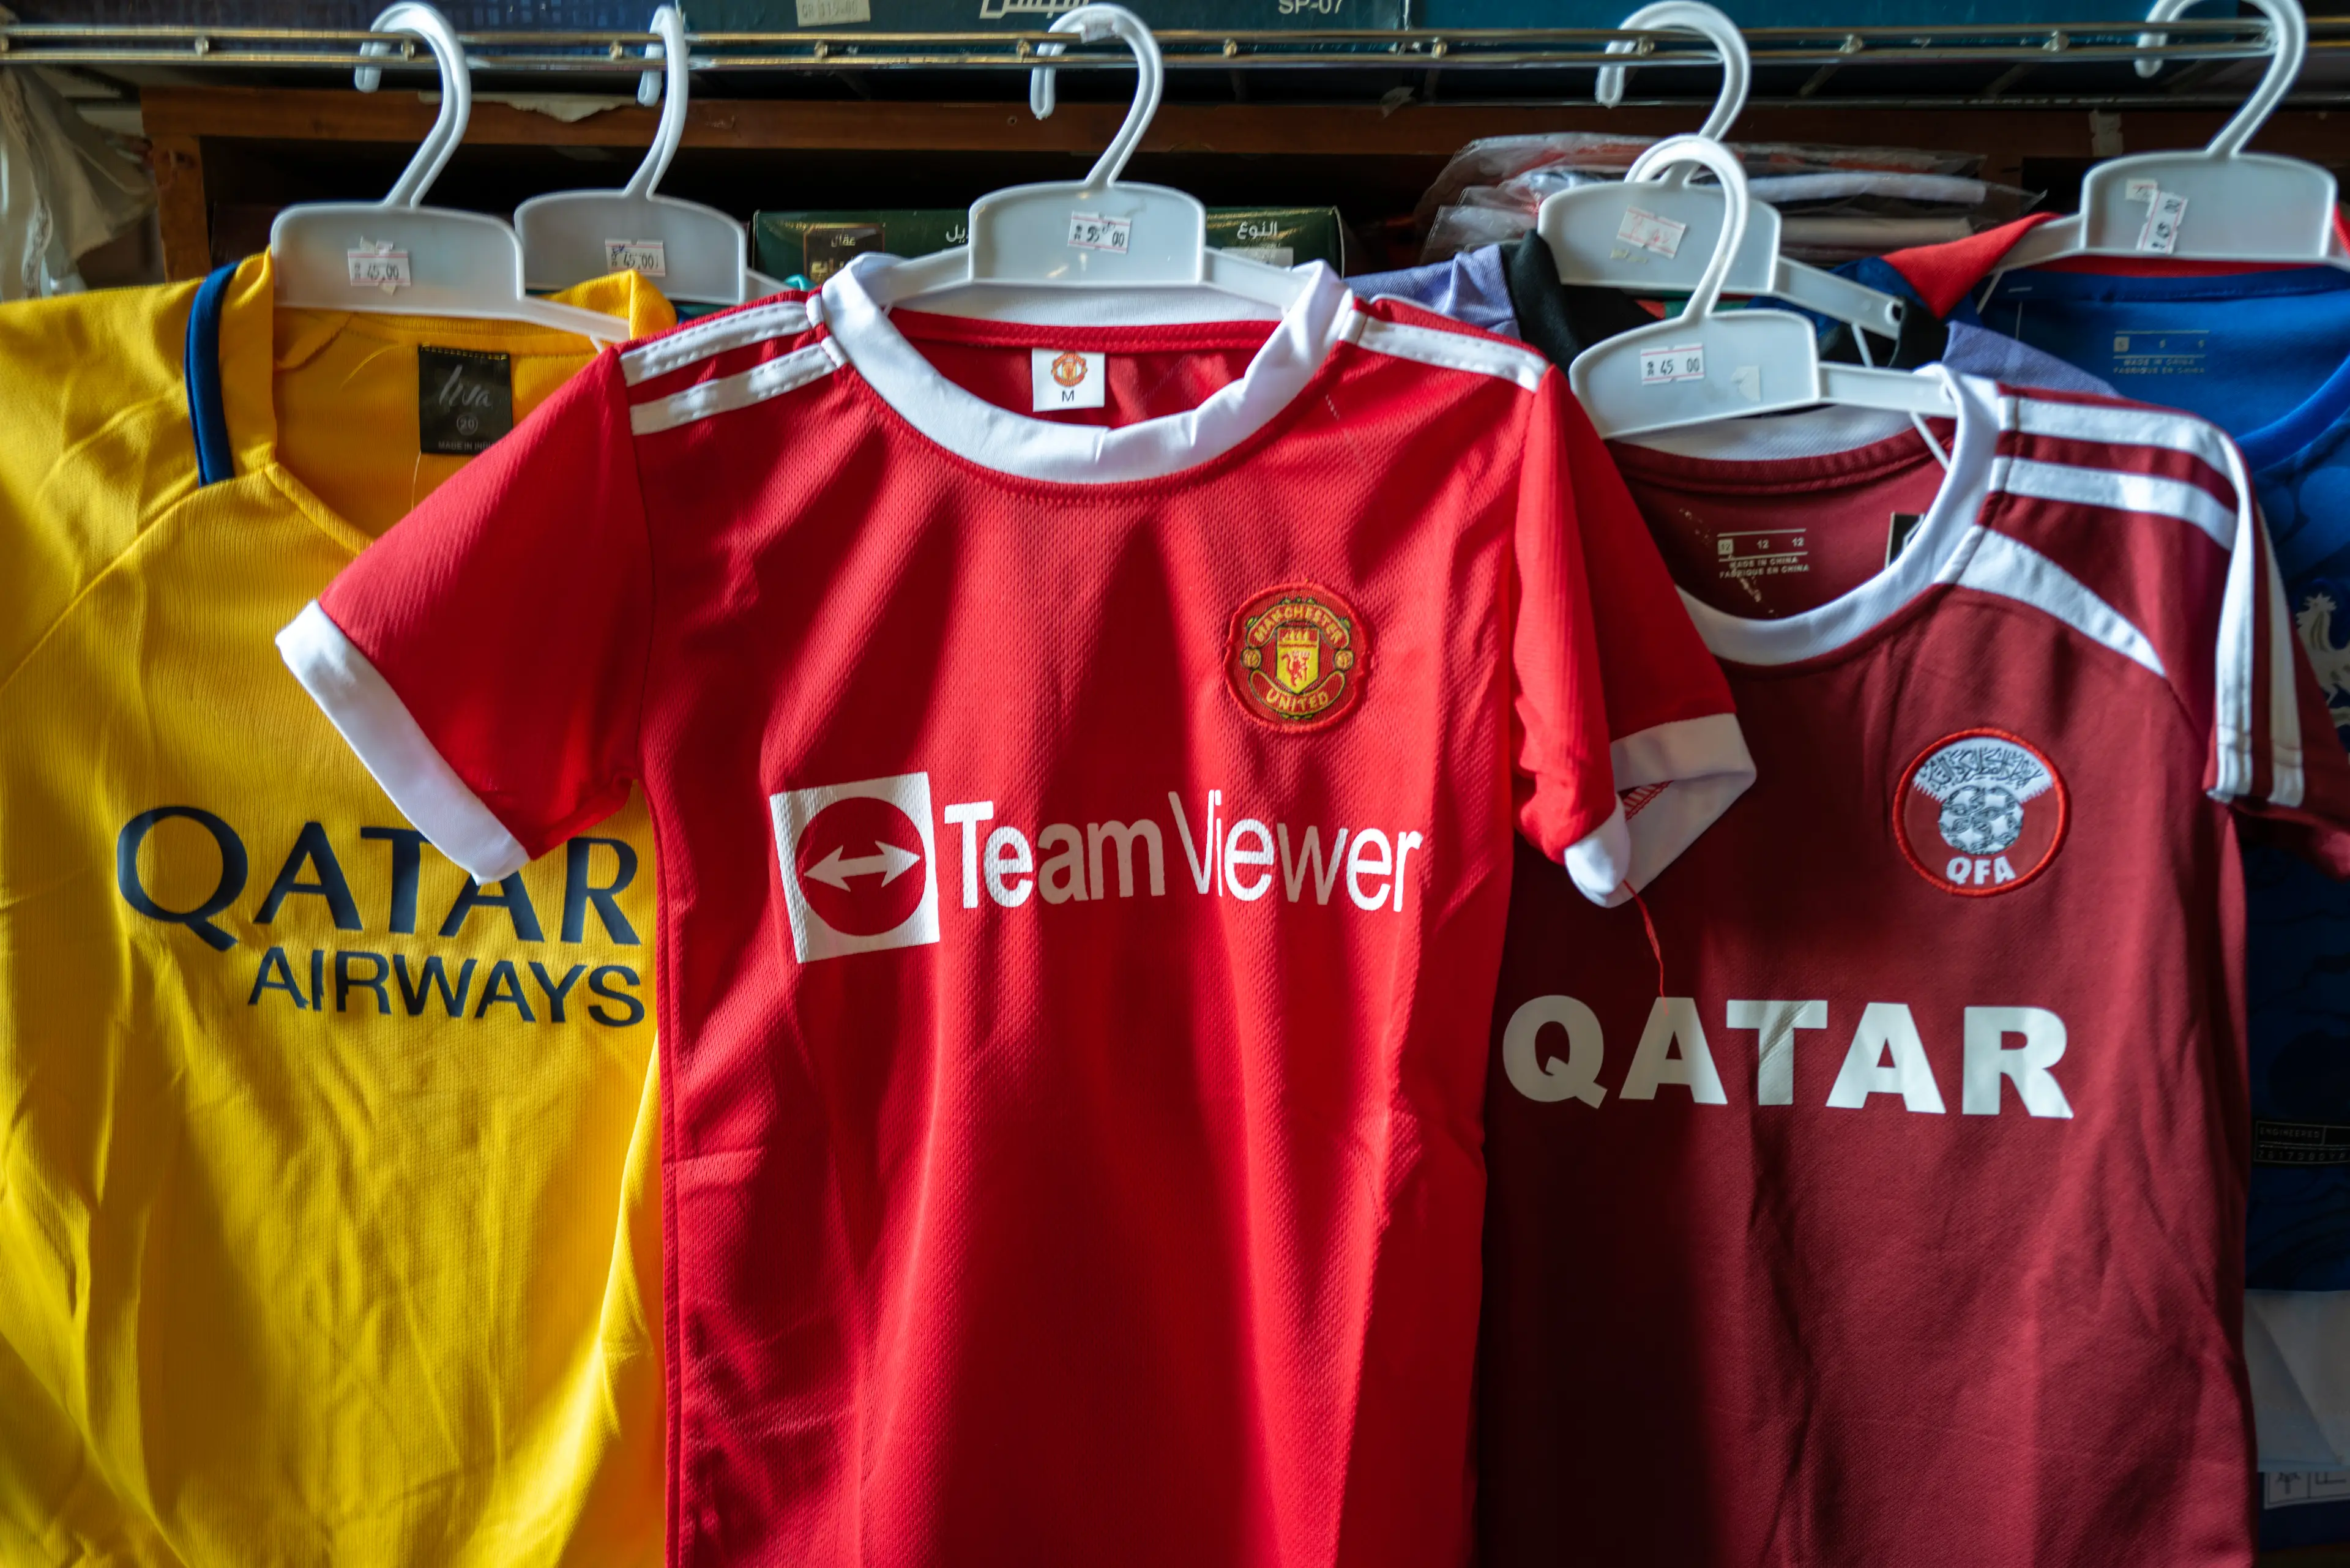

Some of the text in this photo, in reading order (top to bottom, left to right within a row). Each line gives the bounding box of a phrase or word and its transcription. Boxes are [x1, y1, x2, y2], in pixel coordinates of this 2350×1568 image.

[1237, 220, 1278, 240] النوع
[1660, 359, 1674, 375] 45
[1687, 357, 1700, 373] 00
[1062, 390, 1074, 402] M
[1757, 539, 1770, 550] 12
[1792, 537, 1805, 547] 12
[1729, 559, 1755, 569] MADE
[1770, 556, 1799, 566] CHINA
[1781, 564, 1810, 573] CHINA
[1253, 605, 1343, 644] MANCHESTER
[1266, 688, 1329, 711] UNITED
[943, 788, 1423, 913] TeamViewer
[116, 805, 642, 952] QATAR
[1946, 856, 2016, 885] QFA
[247, 946, 646, 1028] AIRWAYS
[1502, 994, 2074, 1119] QATAR
[2259, 1126, 2320, 1138] ENGINEERED
